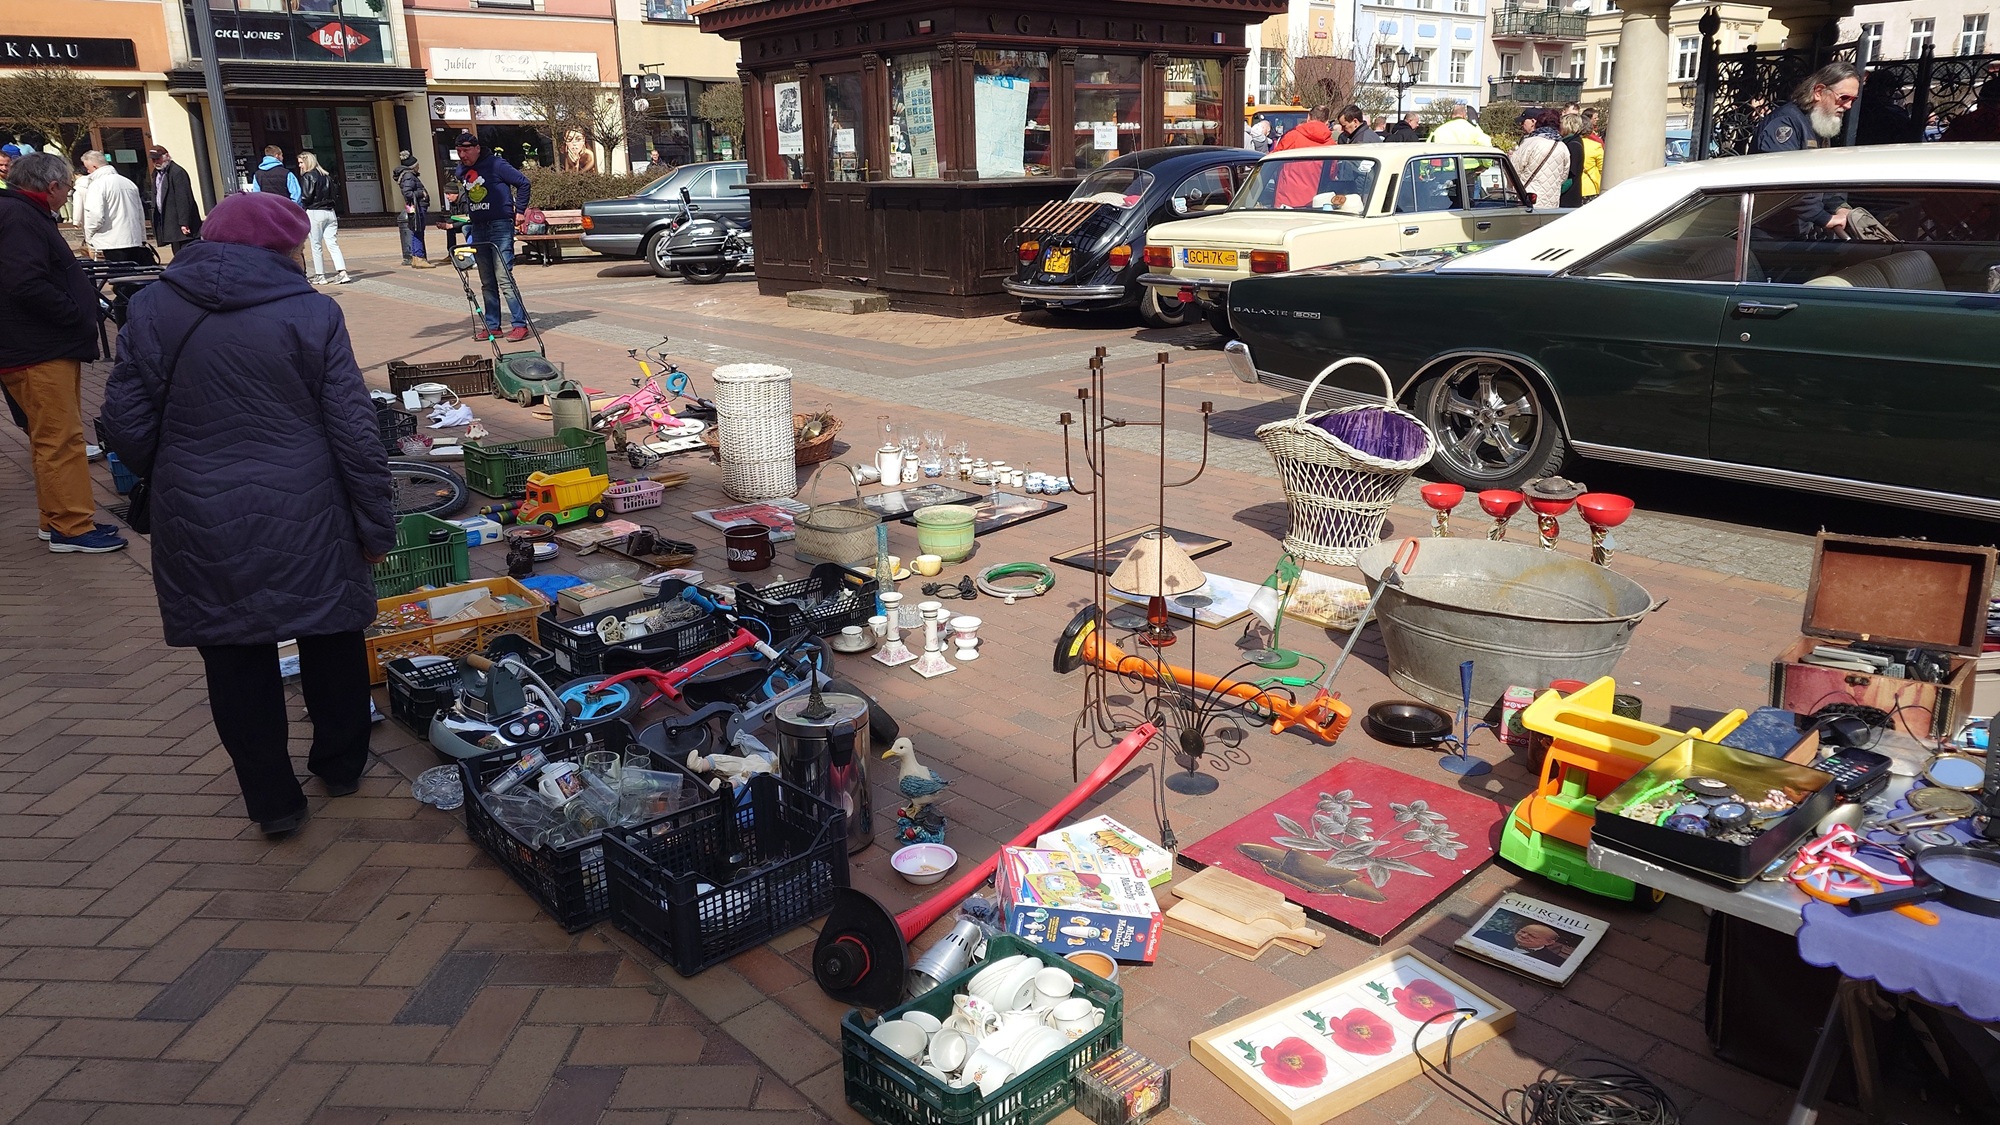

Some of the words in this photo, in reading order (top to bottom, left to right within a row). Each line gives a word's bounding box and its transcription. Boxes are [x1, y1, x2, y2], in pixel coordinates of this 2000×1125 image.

[215, 29, 231, 38] CK
[1016, 15, 1198, 43] GALERIE
[319, 29, 334, 46] Lee
[334, 30, 363, 49] Cper
[4, 42, 79, 59] KALU
[444, 58, 476, 71] Jubiler
[543, 61, 592, 73] Zegarmistrz
[469, 202, 490, 212] GRINCH
[1189, 250, 1210, 263] GCH
[1212, 252, 1224, 264] 7K
[1233, 306, 1288, 316] GALAXIE
[1296, 311, 1318, 319] 500
[1505, 898, 1593, 932] CHURCHILL
